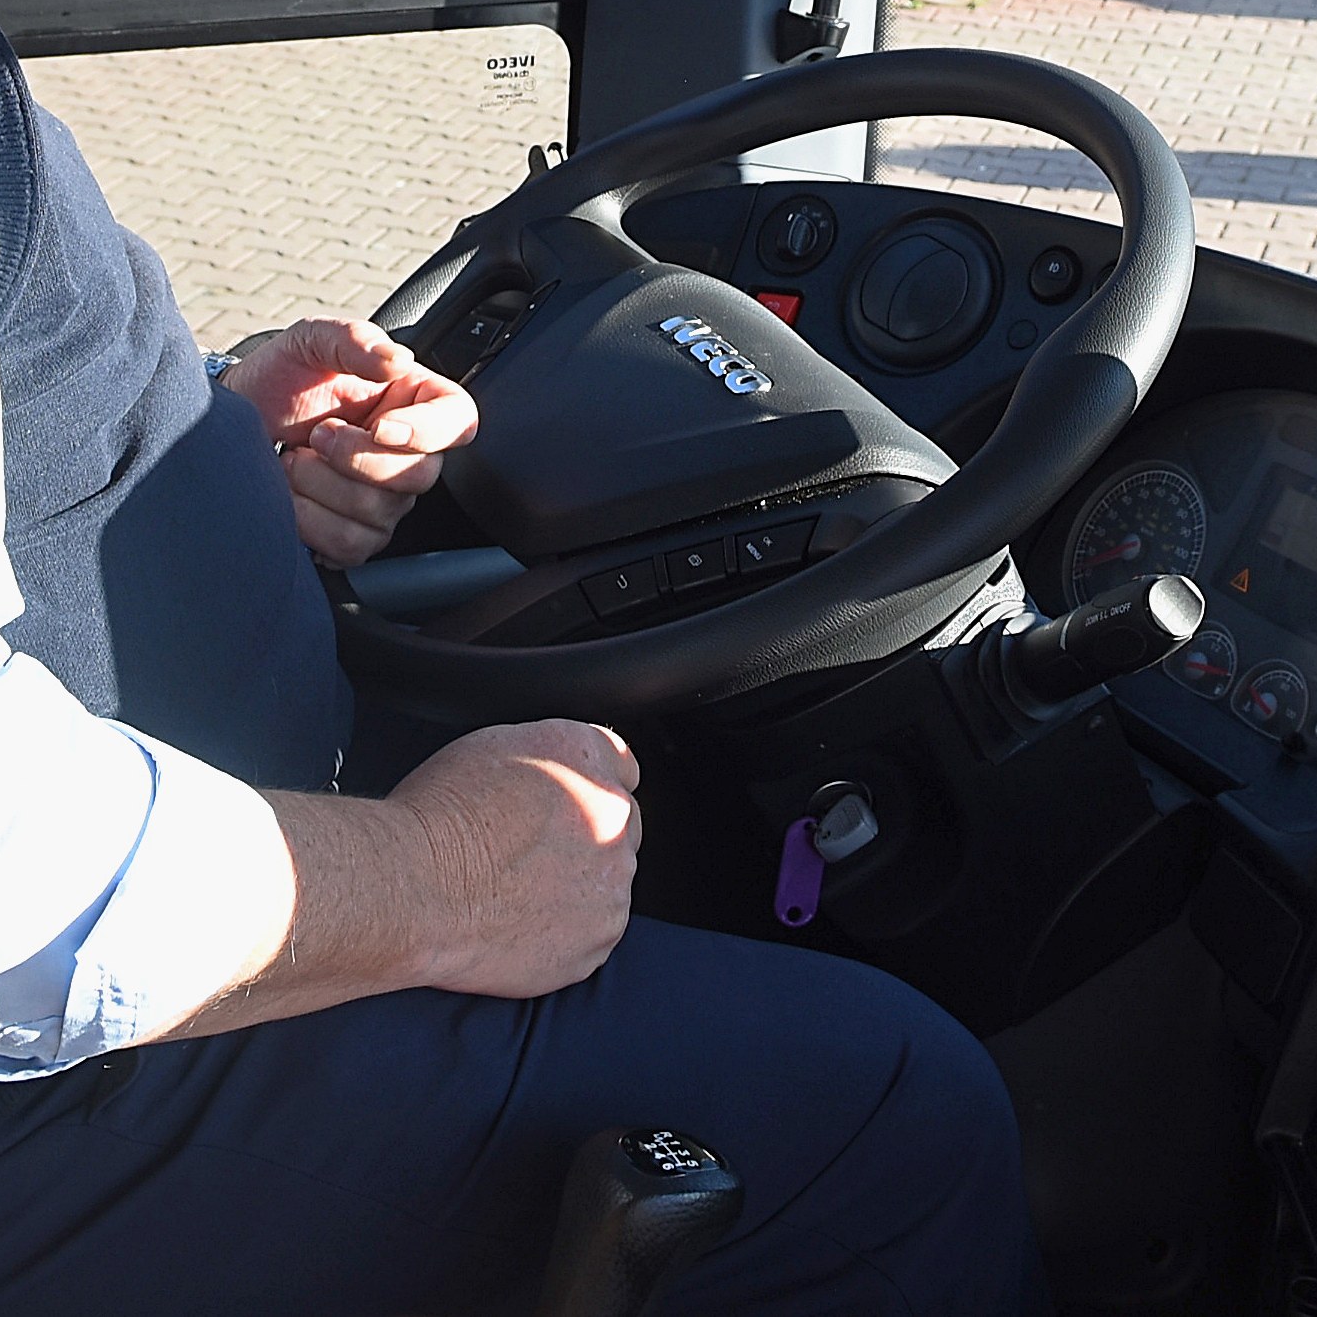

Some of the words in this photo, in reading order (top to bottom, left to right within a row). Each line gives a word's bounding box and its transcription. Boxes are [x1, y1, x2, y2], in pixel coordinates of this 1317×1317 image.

[660, 315, 772, 394] IVECO
[746, 542, 763, 561] MENU
[662, 1162, 675, 1170] 6
[687, 1159, 699, 1167] 5
